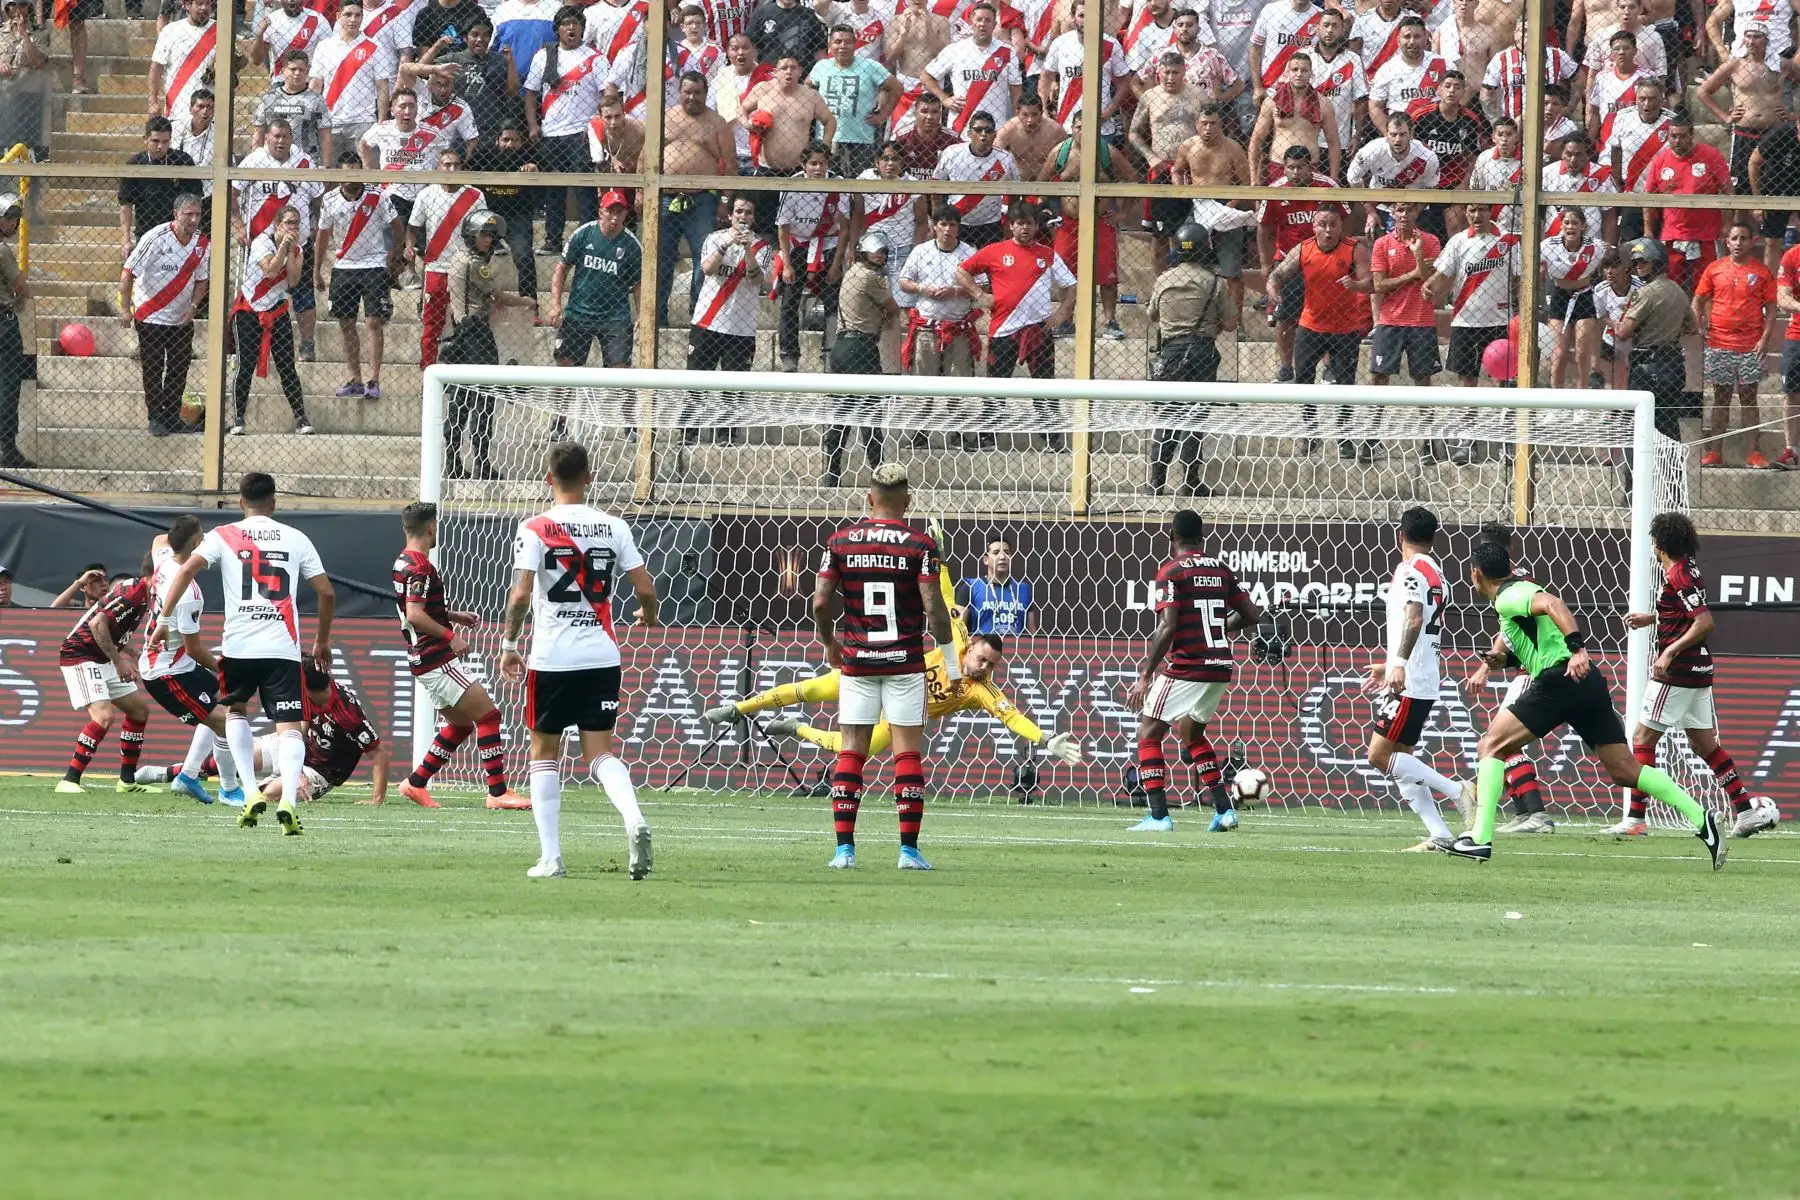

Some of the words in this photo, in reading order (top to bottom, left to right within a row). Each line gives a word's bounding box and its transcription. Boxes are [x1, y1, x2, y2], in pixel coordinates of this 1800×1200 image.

[963, 69, 998, 82] BBVA
[1401, 87, 1437, 100] BBVA
[1428, 139, 1462, 154] BBVA
[583, 254, 618, 275] BBVA
[1464, 257, 1504, 276] Quilmes
[242, 530, 281, 541] PALACIOS
[545, 523, 582, 538] MARTINEZ
[583, 523, 613, 538] QUARTA
[866, 529, 911, 544] MRV
[238, 550, 290, 600] 15
[545, 547, 616, 603] 28
[238, 605, 284, 613] ASSIST
[864, 582, 898, 641] 9
[251, 613, 285, 621] CARD
[1194, 599, 1229, 648] 15
[88, 667, 103, 679] 18
[276, 701, 302, 711] AXE
[601, 700, 619, 711] AX
[838, 802, 855, 810] CRF
